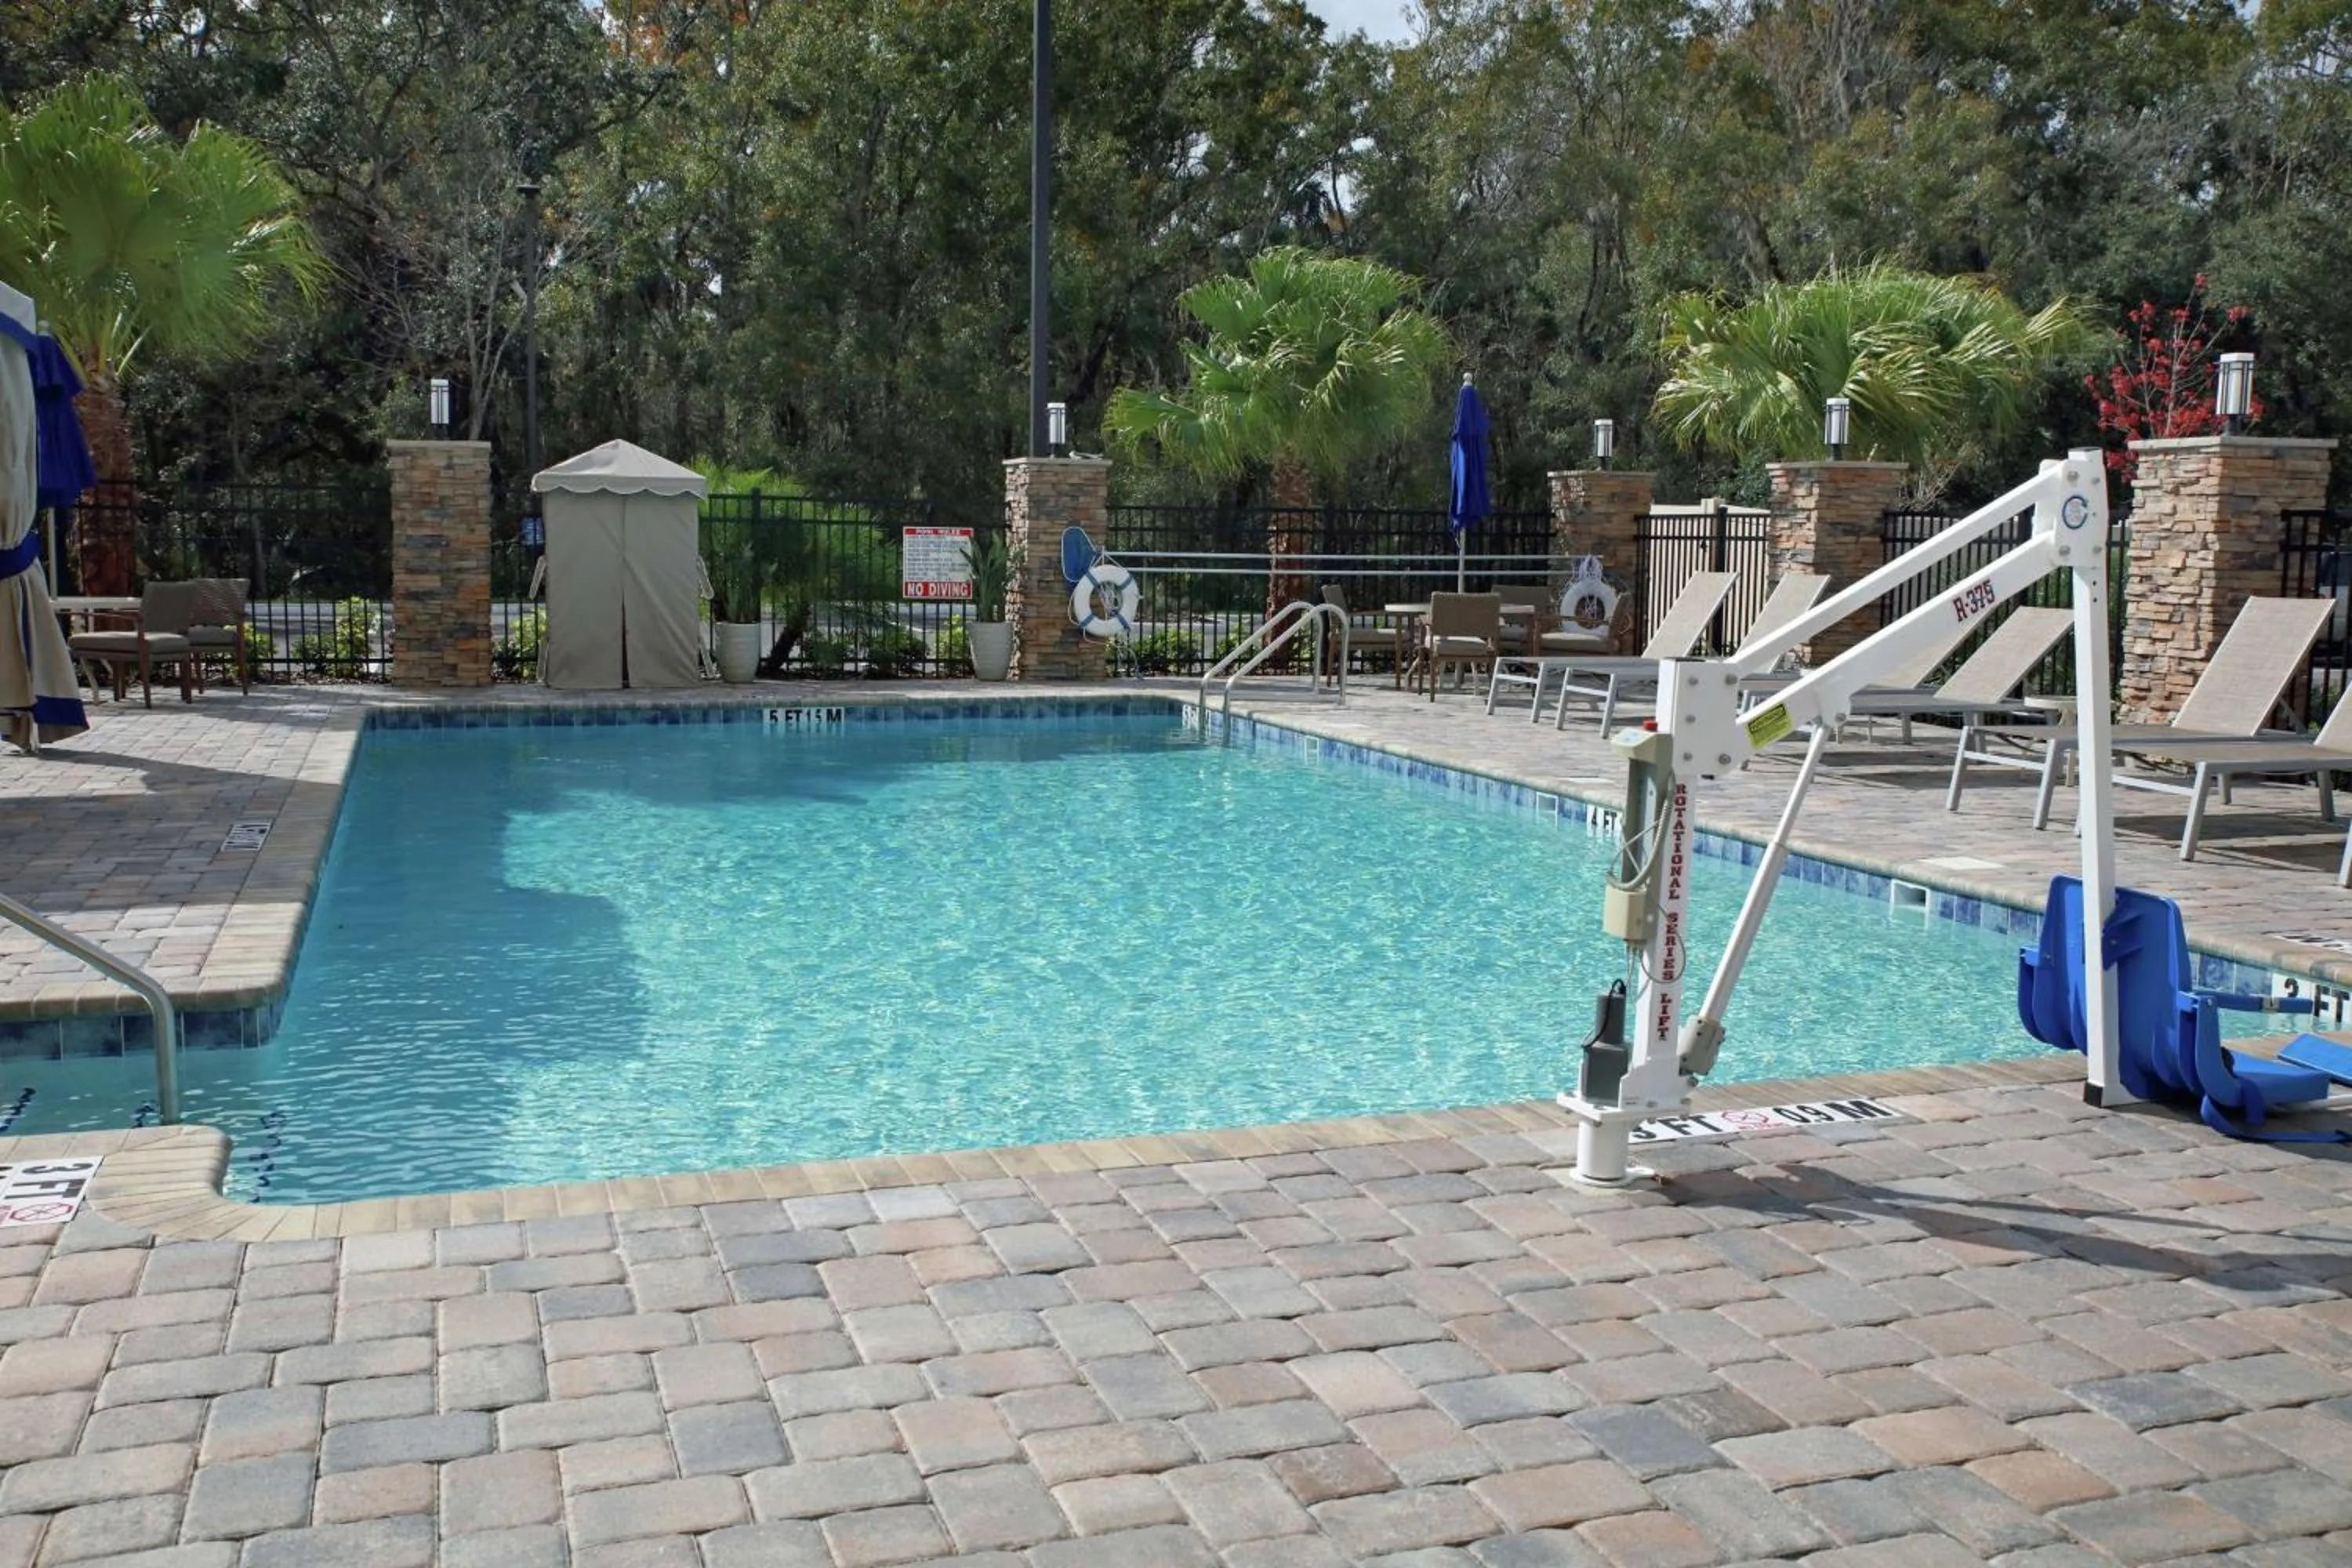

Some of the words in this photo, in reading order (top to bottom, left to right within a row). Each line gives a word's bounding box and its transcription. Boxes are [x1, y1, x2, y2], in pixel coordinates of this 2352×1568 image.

[908, 583, 923, 596] NO
[929, 583, 968, 597] DIVING
[785, 710, 803, 722] FT
[826, 708, 842, 722] M
[1603, 810, 1617, 830] FT
[1668, 784, 1686, 899] ROTATIONAL
[1663, 913, 1679, 980] SERIES
[1657, 993, 1672, 1038] LIFT
[2314, 984, 2350, 1022] FT
[1656, 1114, 1723, 1136] FT
[1823, 1101, 1893, 1120] M
[21, 1163, 94, 1175] 3
[3, 1178, 87, 1200] FT
